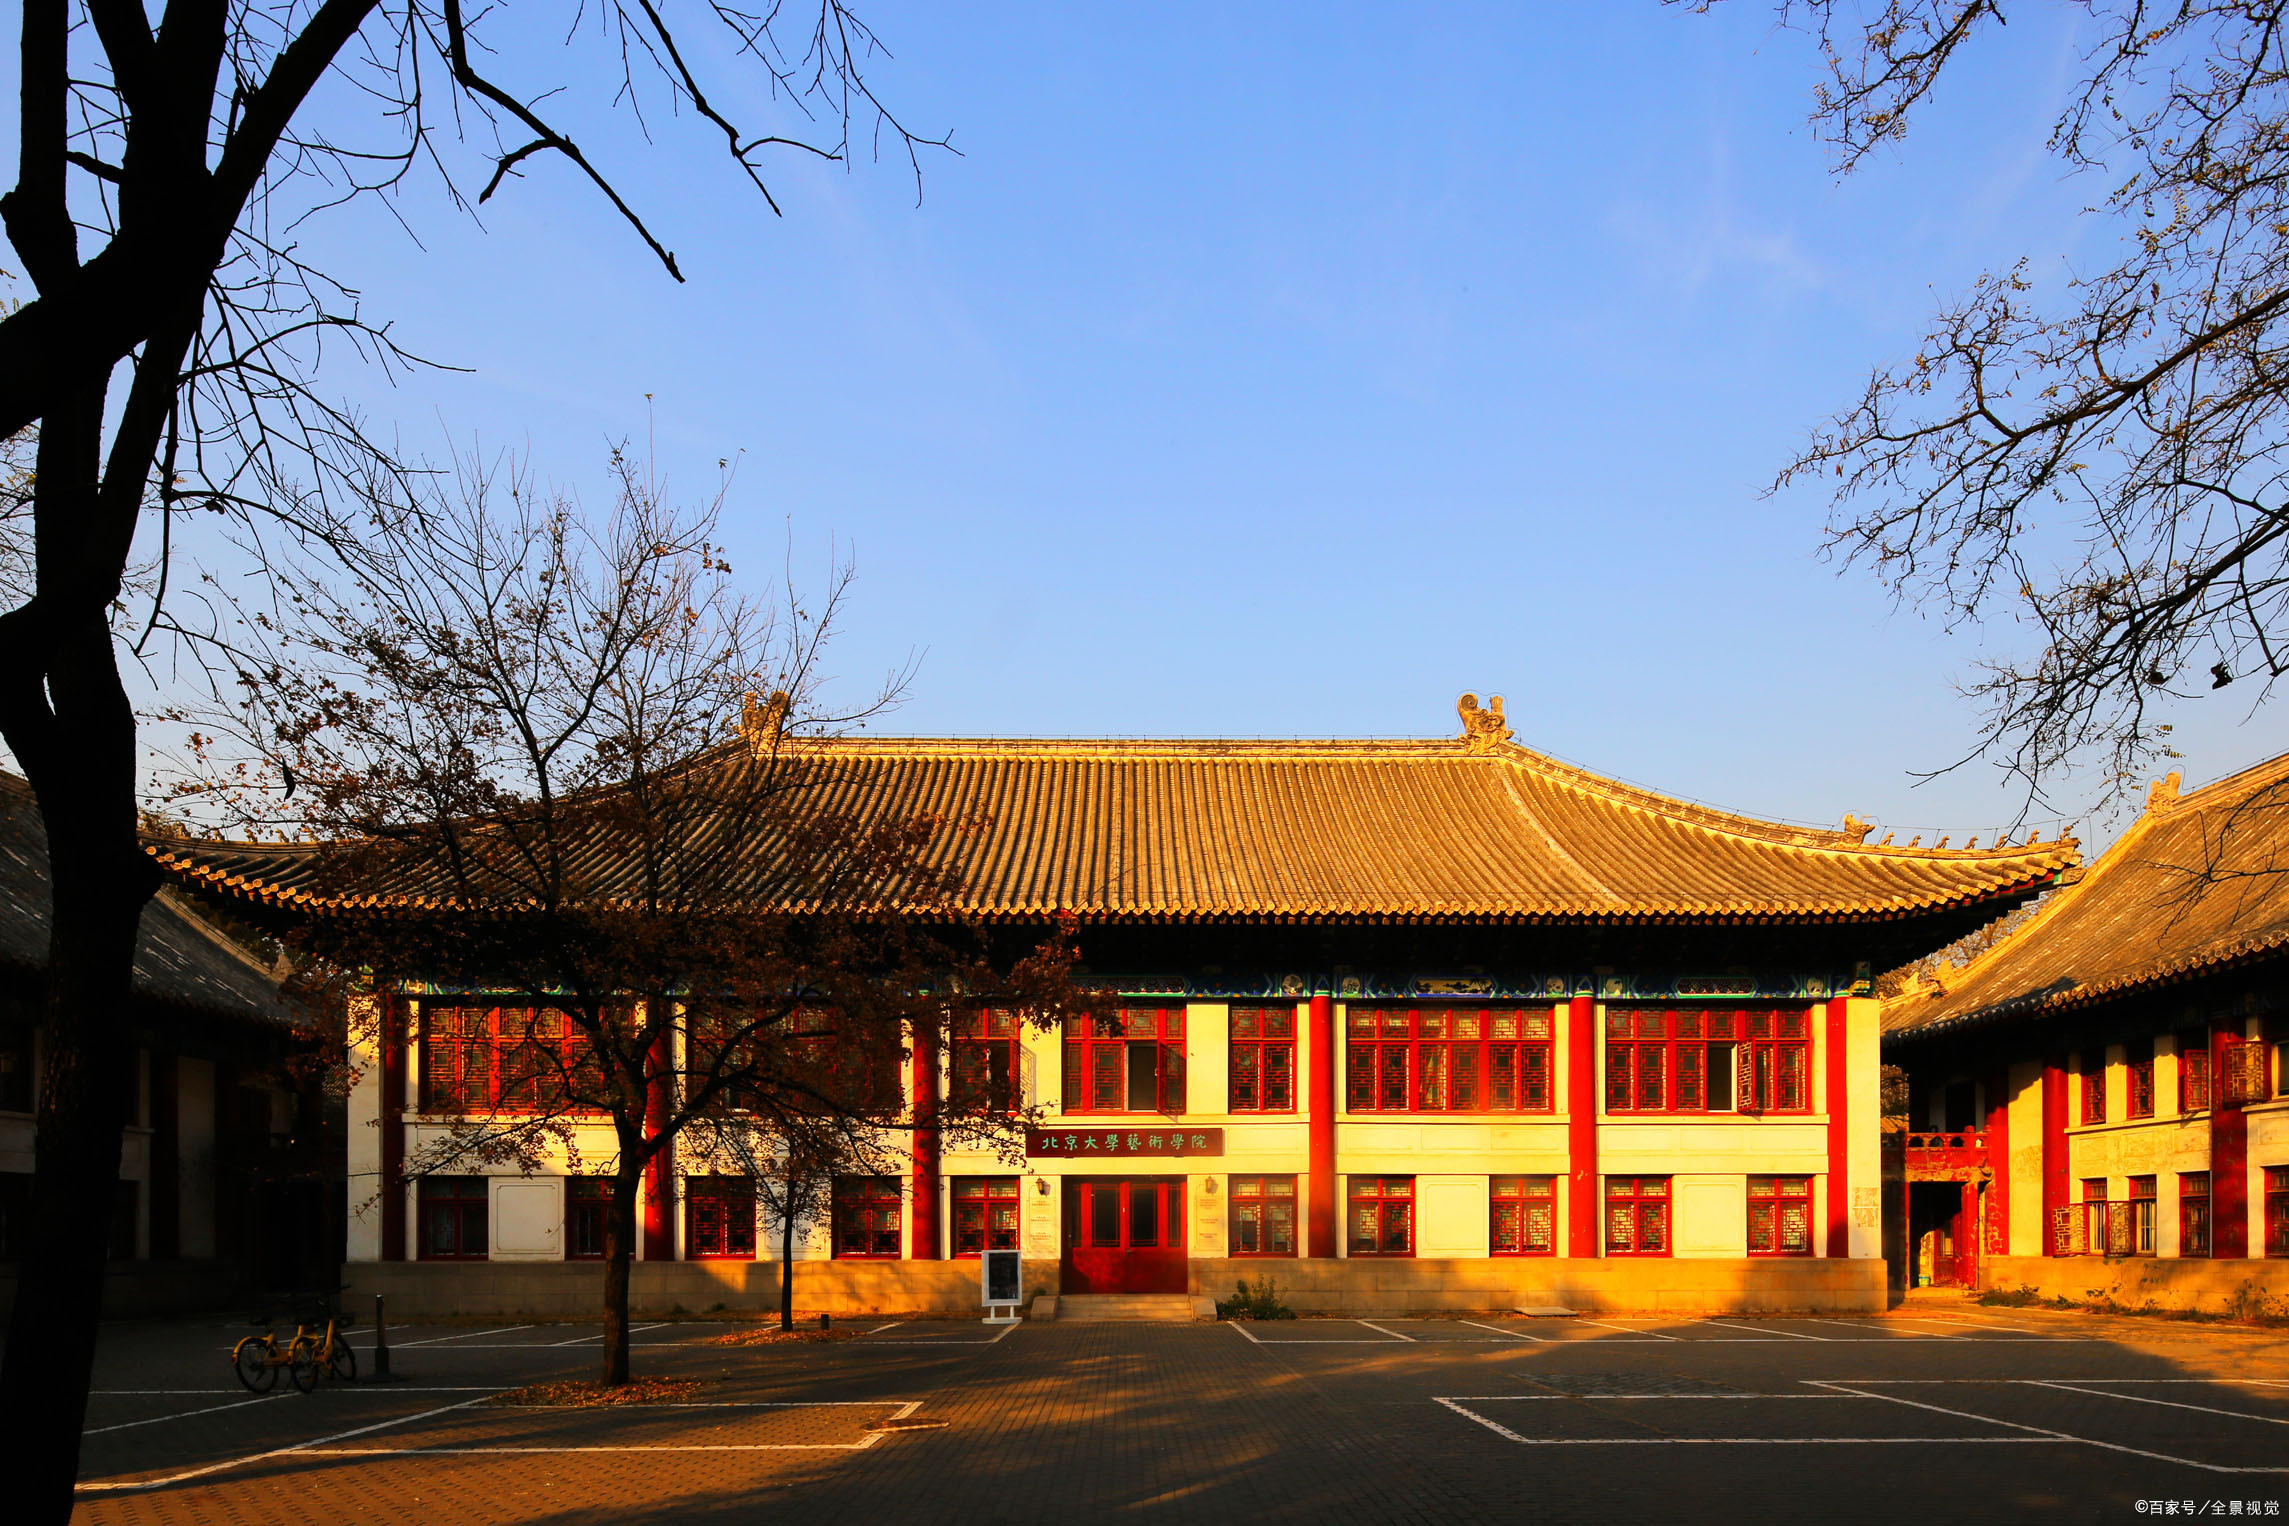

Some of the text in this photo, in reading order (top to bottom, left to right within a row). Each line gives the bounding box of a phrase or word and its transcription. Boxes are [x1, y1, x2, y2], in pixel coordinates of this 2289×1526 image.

[1041, 1133, 1208, 1152] 北京大學藝術學院
